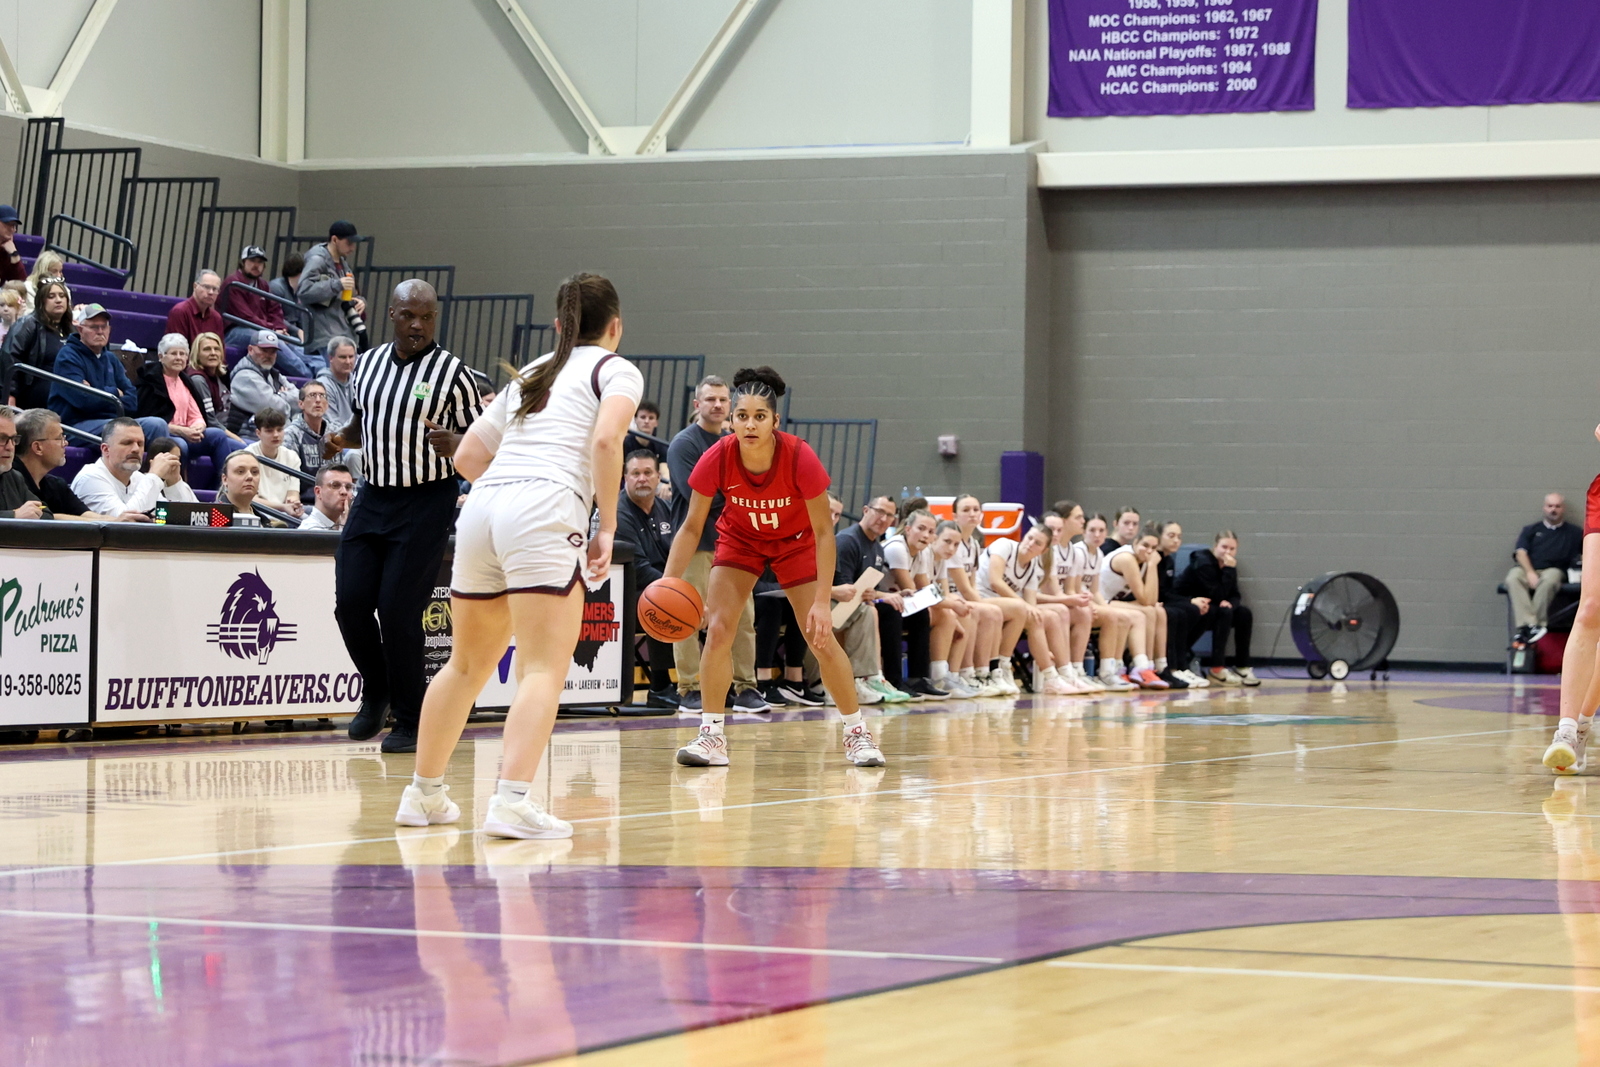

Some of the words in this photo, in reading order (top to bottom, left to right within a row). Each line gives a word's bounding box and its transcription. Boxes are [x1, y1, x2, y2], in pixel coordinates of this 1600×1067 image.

[1088, 14, 1120, 28] MOC
[1123, 12, 1200, 28] Champions:
[1204, 9, 1238, 24] 1962,
[1242, 8, 1273, 22] 1967
[1101, 30, 1140, 44] HBCC
[1142, 28, 1221, 45] Champions:
[1228, 26, 1259, 40] 1972
[1068, 48, 1102, 62] NAIA
[1103, 47, 1157, 61] National
[1159, 44, 1217, 61] Playoffs:
[1223, 43, 1258, 58] 1987,
[1106, 64, 1137, 78] AMC
[1140, 62, 1218, 78] Champions:
[1221, 60, 1252, 74] 1994
[1100, 81, 1139, 95] HCAC
[1142, 80, 1219, 95] Champions:
[1226, 77, 1257, 92] 2000
[731, 495, 791, 509] BELLEVUE
[748, 511, 779, 531] 14
[0, 577, 84, 658] Padrone's
[583, 601, 615, 621] MERS
[579, 621, 620, 642] IPMENT
[40, 634, 78, 653] PIZZA
[105, 672, 362, 711] BLUFFTONBEAVERS.CO
[564, 680, 573, 690] ANA
[579, 679, 601, 690] LAKEVIEW
[606, 679, 618, 689] ELIDA
